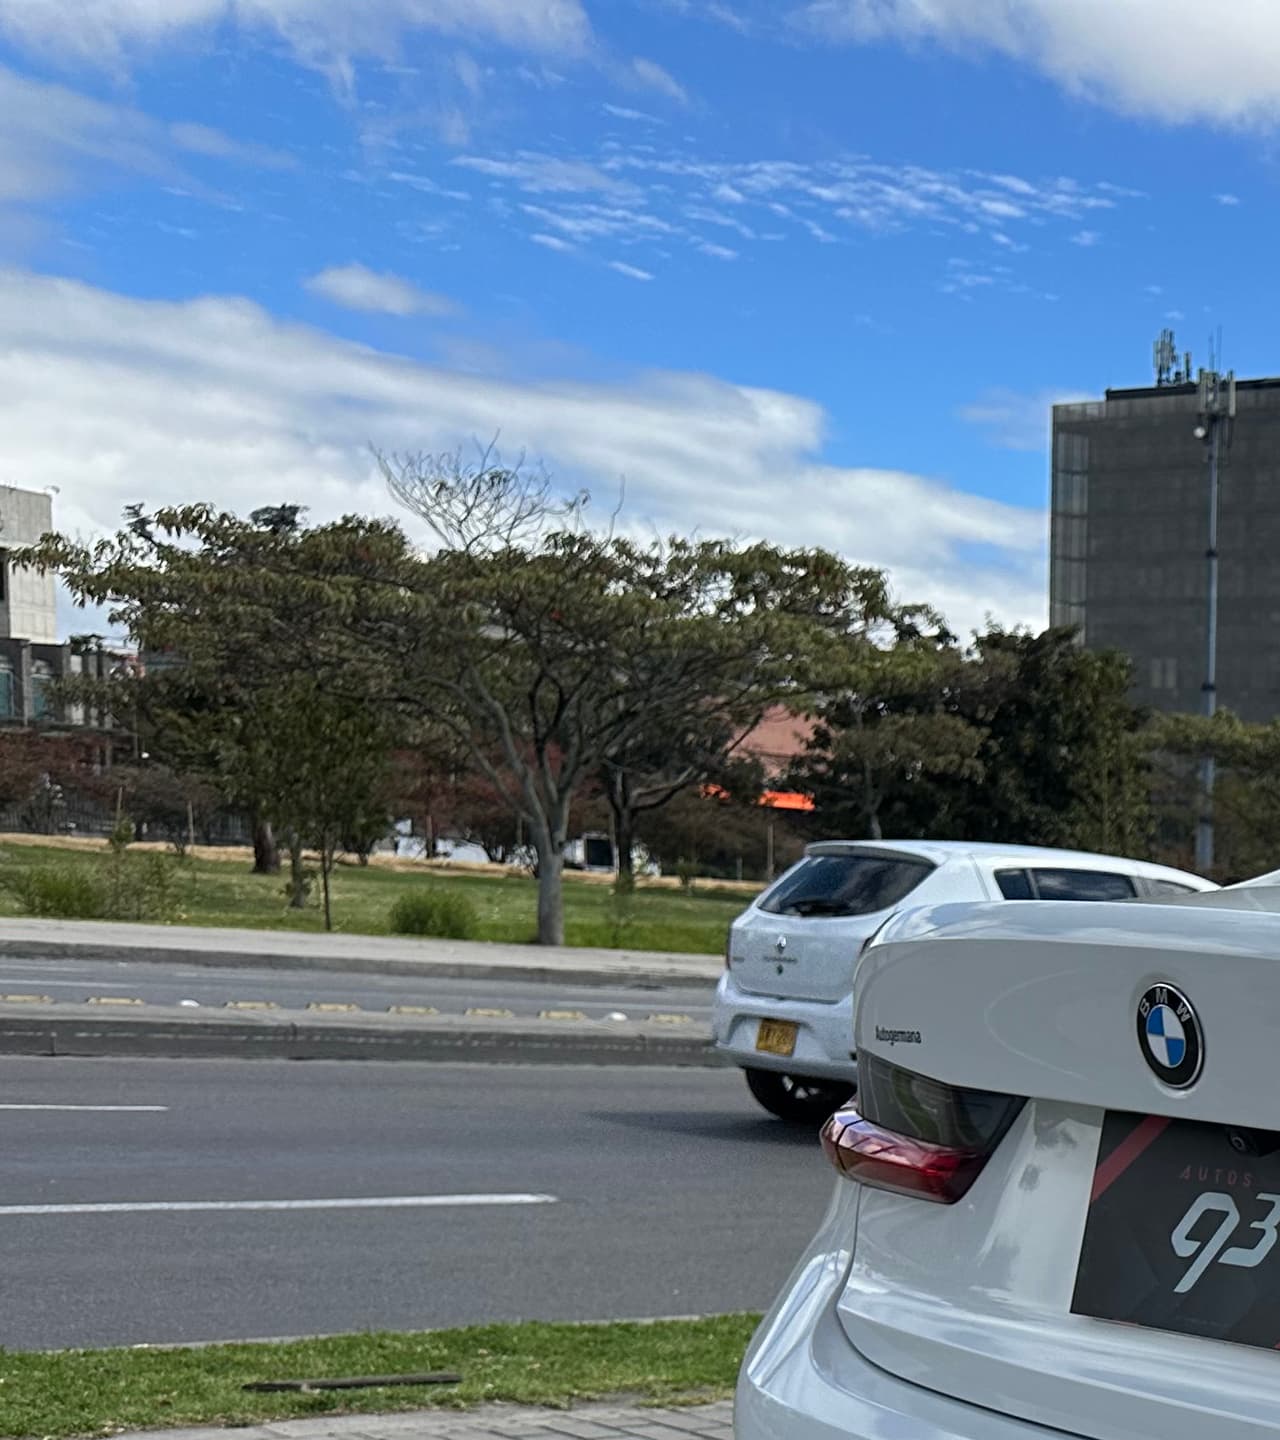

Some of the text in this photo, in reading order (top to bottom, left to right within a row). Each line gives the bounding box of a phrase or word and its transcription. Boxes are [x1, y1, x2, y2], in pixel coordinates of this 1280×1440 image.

[1140, 987, 1191, 1022] BMW
[875, 1025, 922, 1046] Autogermana
[1180, 1164, 1255, 1187] AUTOS
